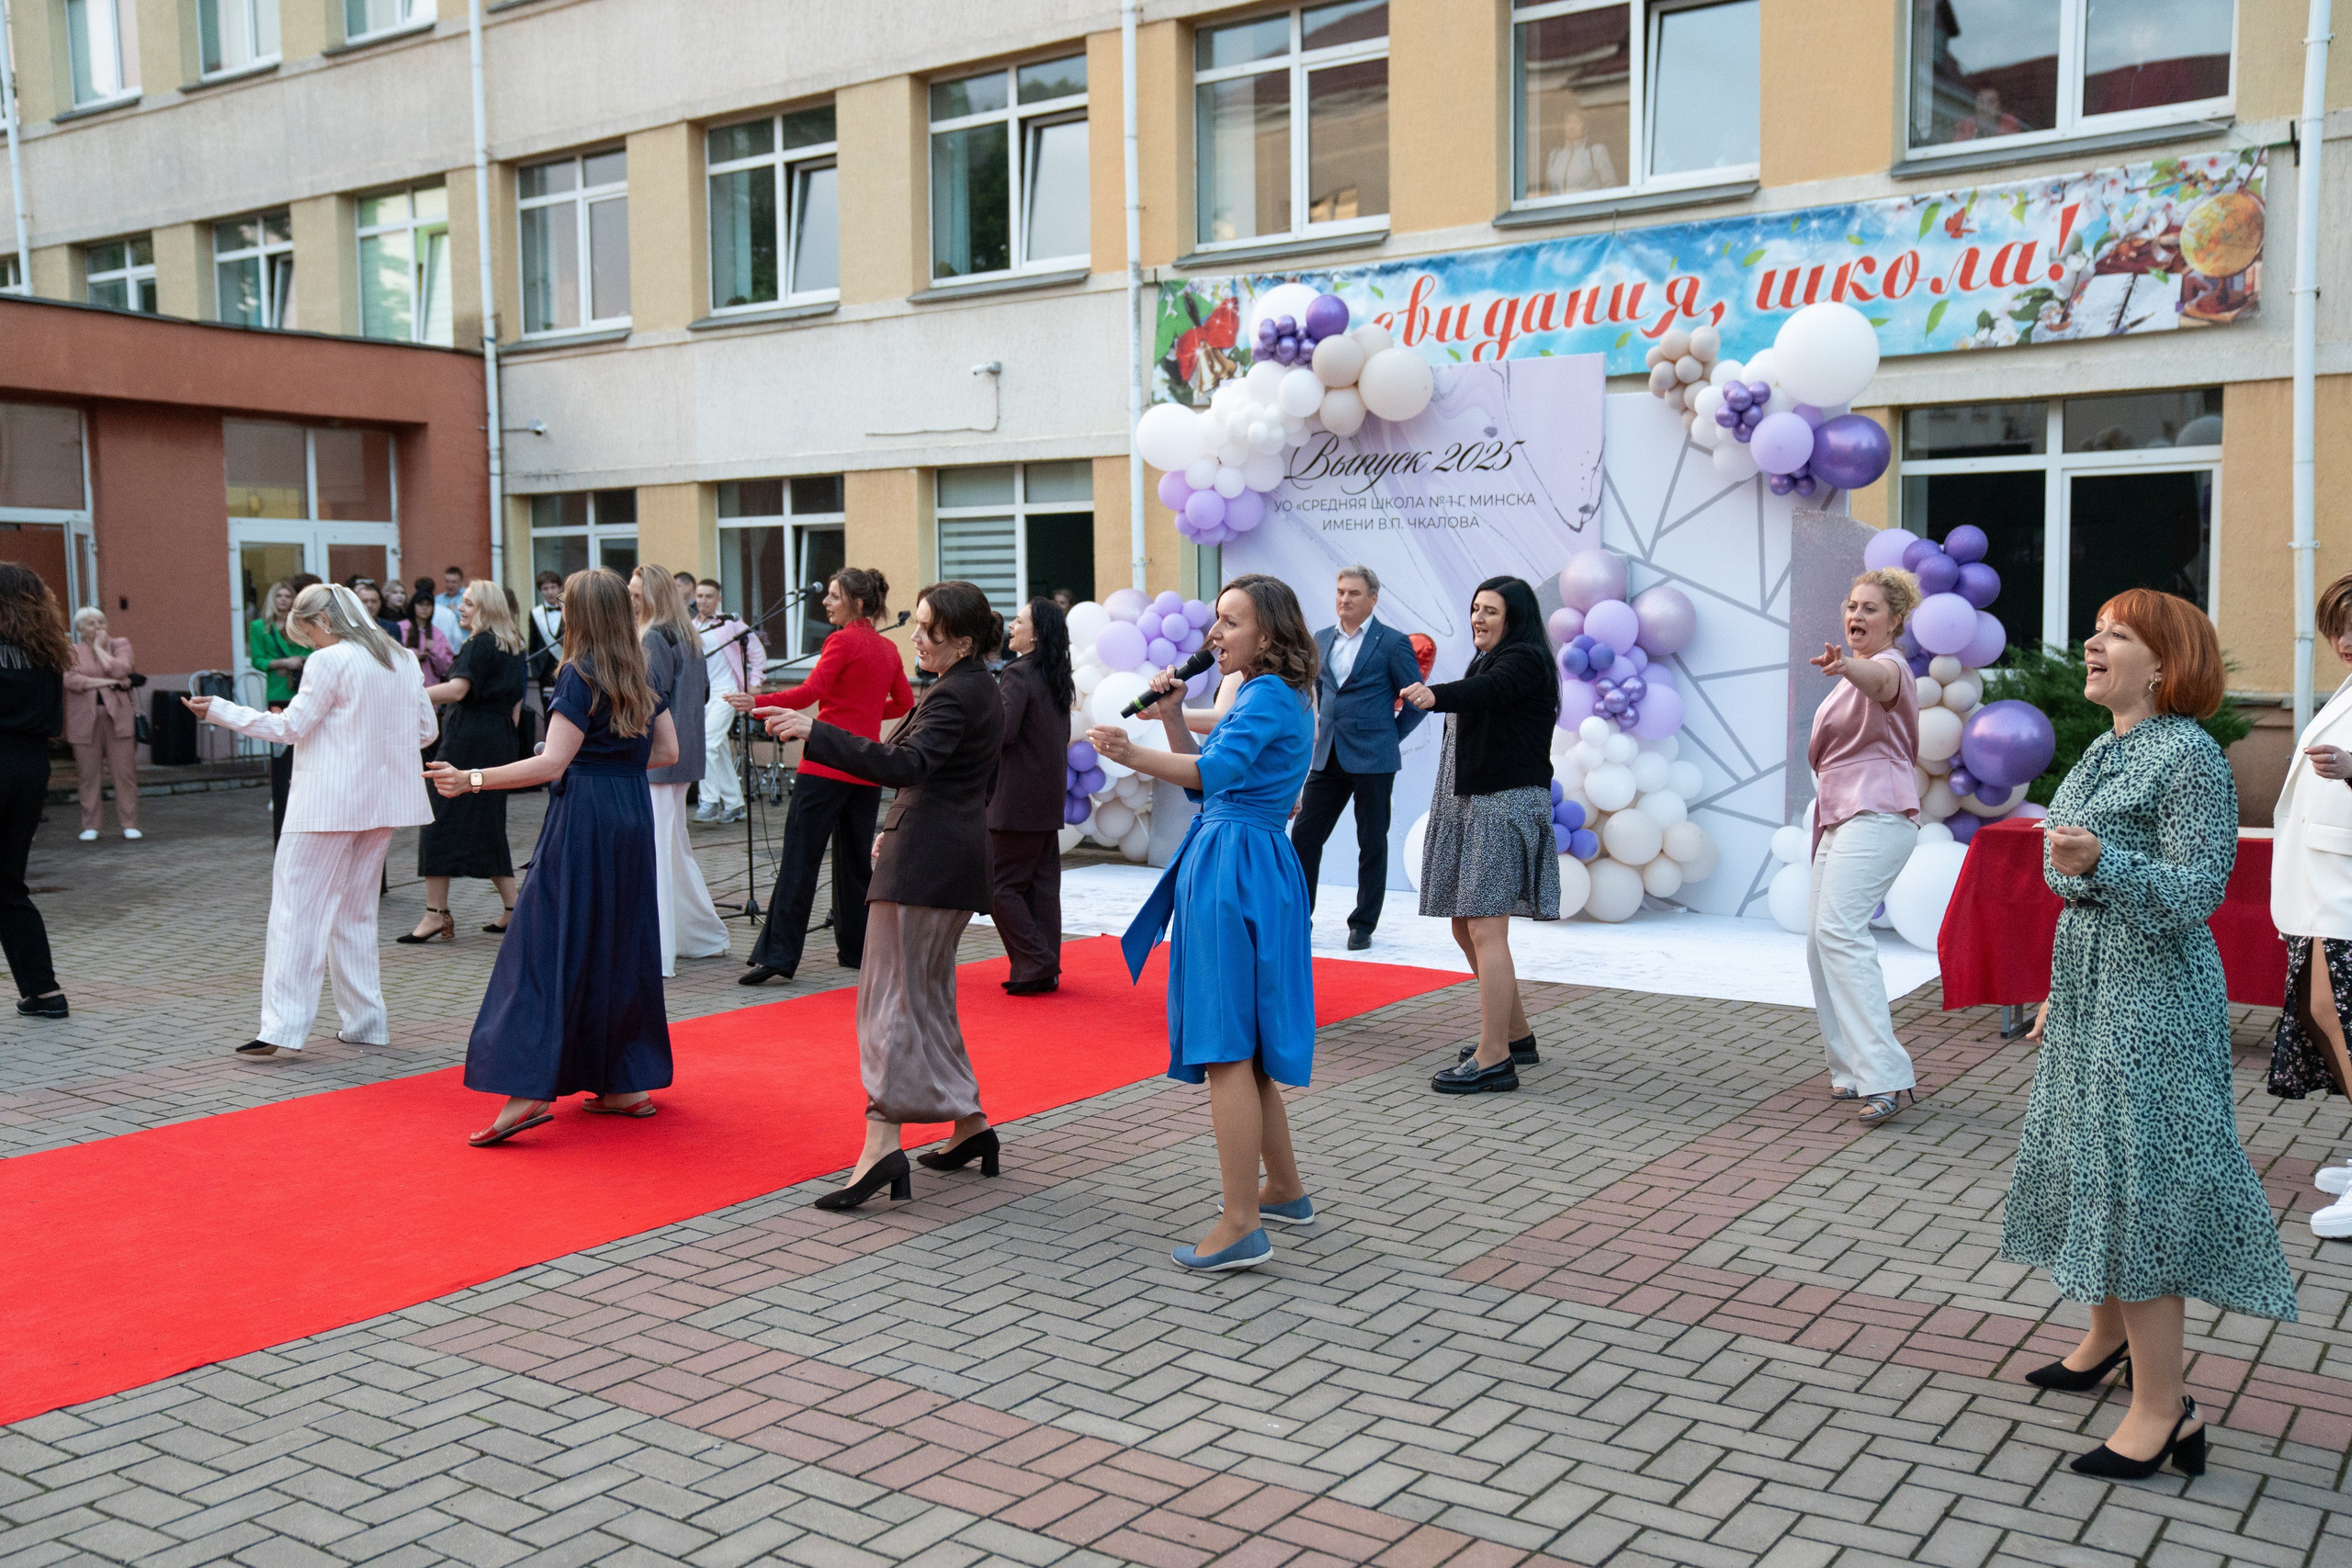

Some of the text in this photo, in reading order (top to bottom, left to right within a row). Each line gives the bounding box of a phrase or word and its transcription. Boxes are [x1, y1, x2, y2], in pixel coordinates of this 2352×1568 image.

[1756, 202, 2081, 310] школа!
[1283, 430, 1526, 495] Выпуск 2025
[1273, 500, 1293, 513] УО
[1296, 498, 1367, 513] «СРЕДНЯЯ
[1372, 496, 1425, 510] ШКОЛА
[1470, 493, 1537, 507] МИНСКА
[1323, 516, 1480, 531] ИМЕНИ В.П. ЧКАЛОВА
